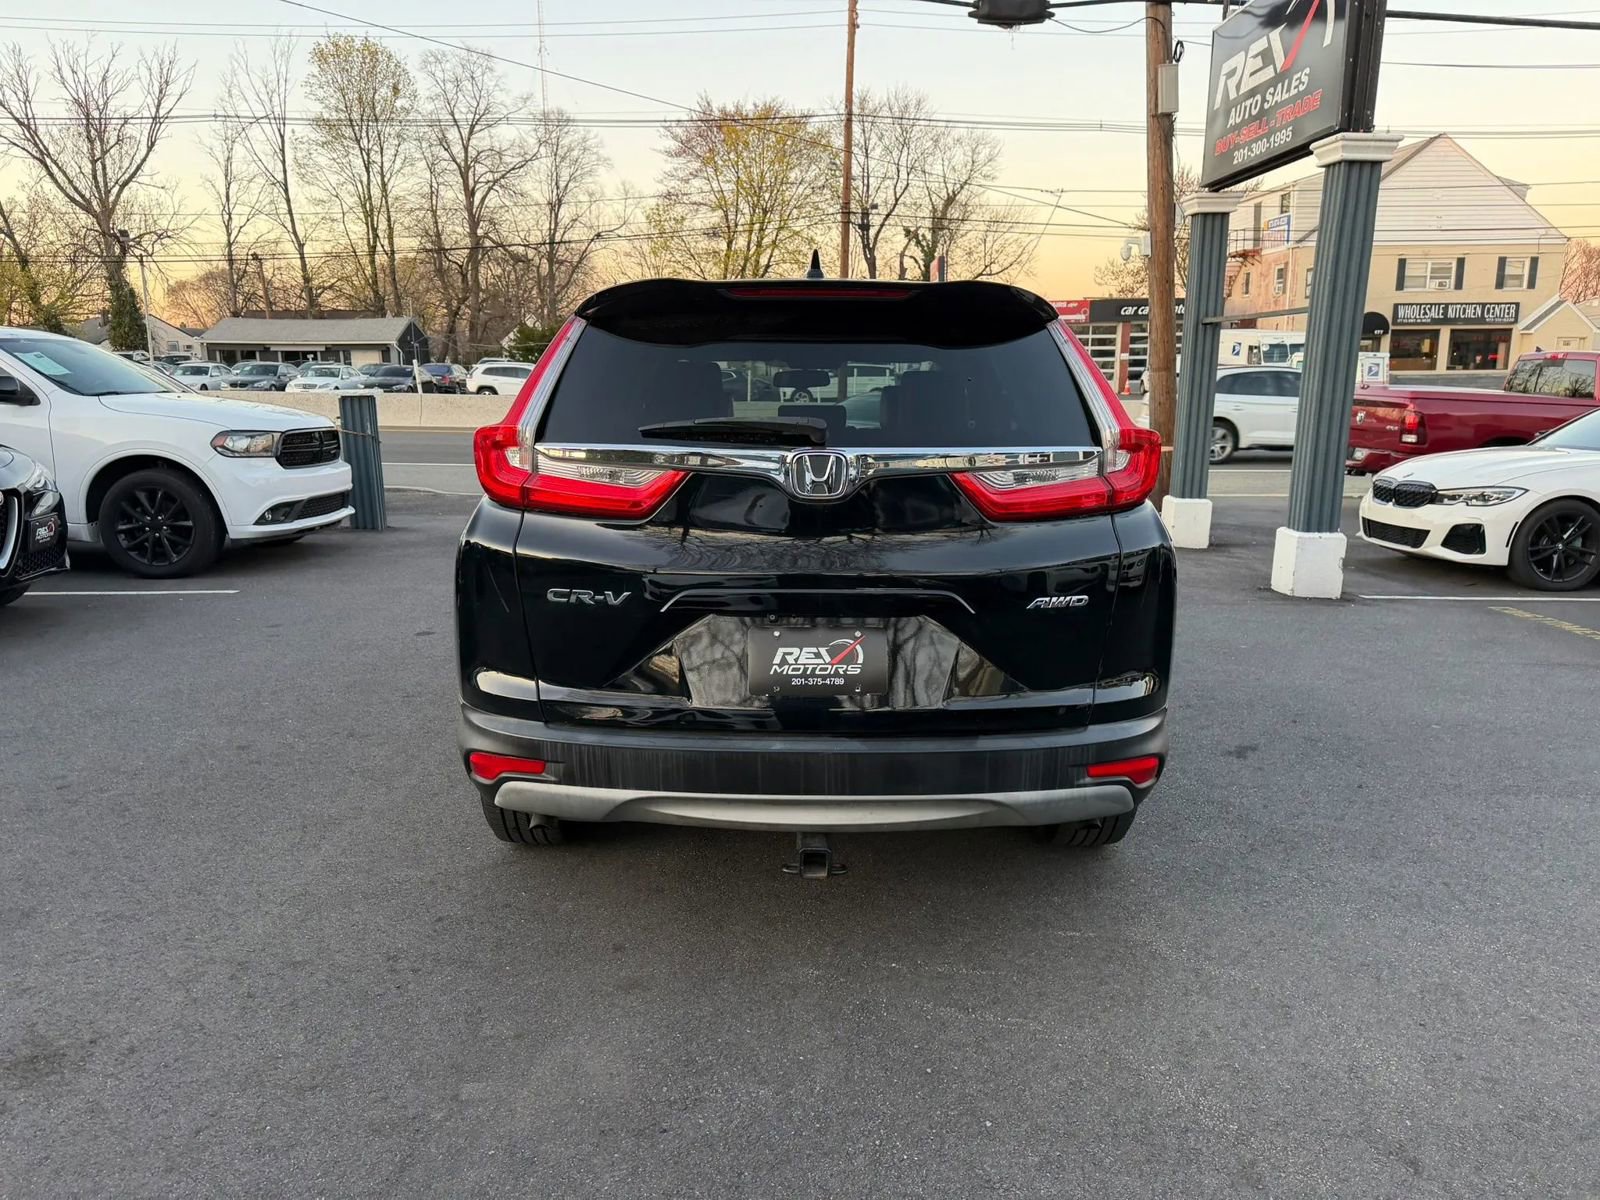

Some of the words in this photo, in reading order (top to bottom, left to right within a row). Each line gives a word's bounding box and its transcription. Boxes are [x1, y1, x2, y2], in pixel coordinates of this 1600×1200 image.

[1227, 94, 1262, 128] AUTO
[1263, 67, 1310, 109] SALES
[1233, 126, 1293, 165] 201-300-1995
[1120, 306, 1138, 315] car
[1138, 306, 1149, 315] ca
[1398, 304, 1445, 319] WHOLESALE
[1447, 304, 1482, 318] KITCHEN
[1484, 303, 1516, 318] CENTER
[547, 588, 632, 606] CR-V
[1026, 595, 1089, 609] AWD
[769, 664, 862, 675] MOTORS
[791, 677, 845, 686] 201-375-4789
